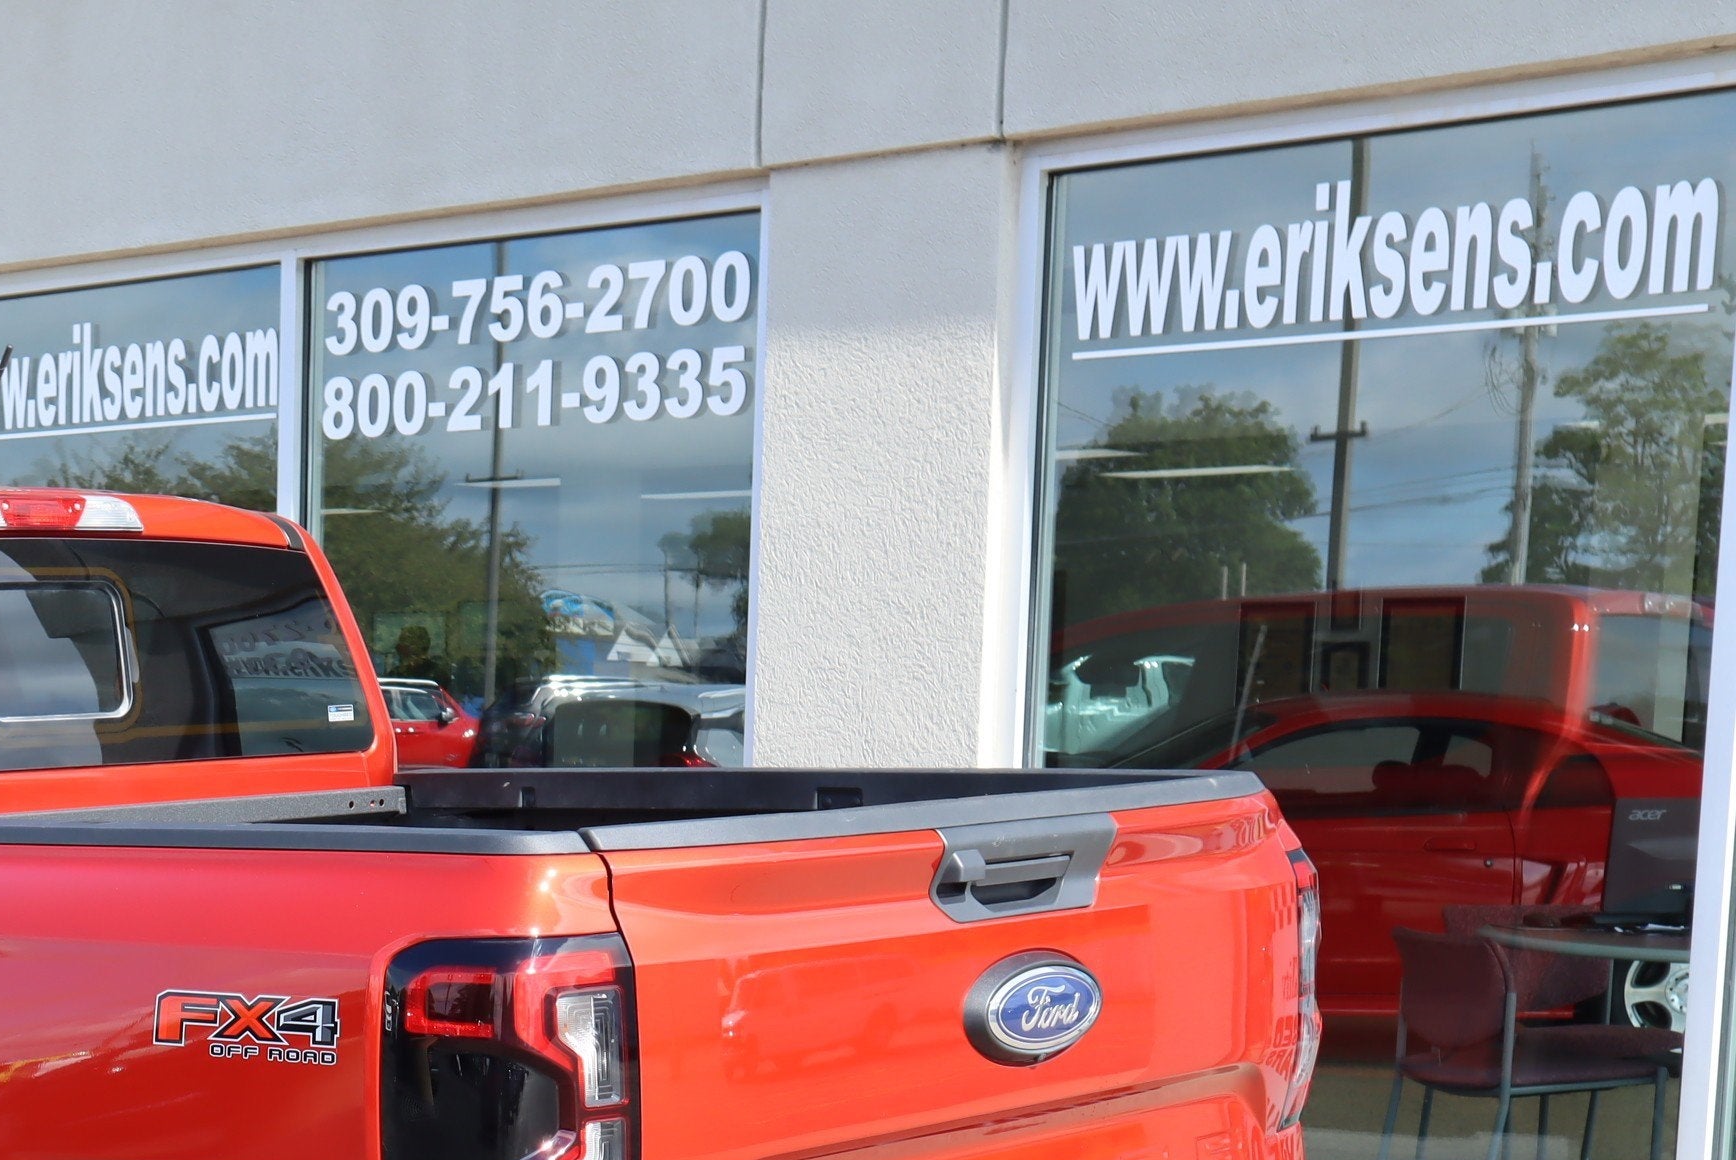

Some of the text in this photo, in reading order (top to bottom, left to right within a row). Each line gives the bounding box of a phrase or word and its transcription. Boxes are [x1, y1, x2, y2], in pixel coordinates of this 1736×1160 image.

[1072, 176, 1719, 341] www.eriksens.com
[324, 250, 752, 356] 309-756-2700
[322, 345, 748, 440] 800-211-9335
[1628, 808, 1667, 821] acer
[153, 989, 341, 1048] FX4
[1021, 984, 1081, 1032] Ford
[209, 1044, 337, 1066] OFF ROAD
